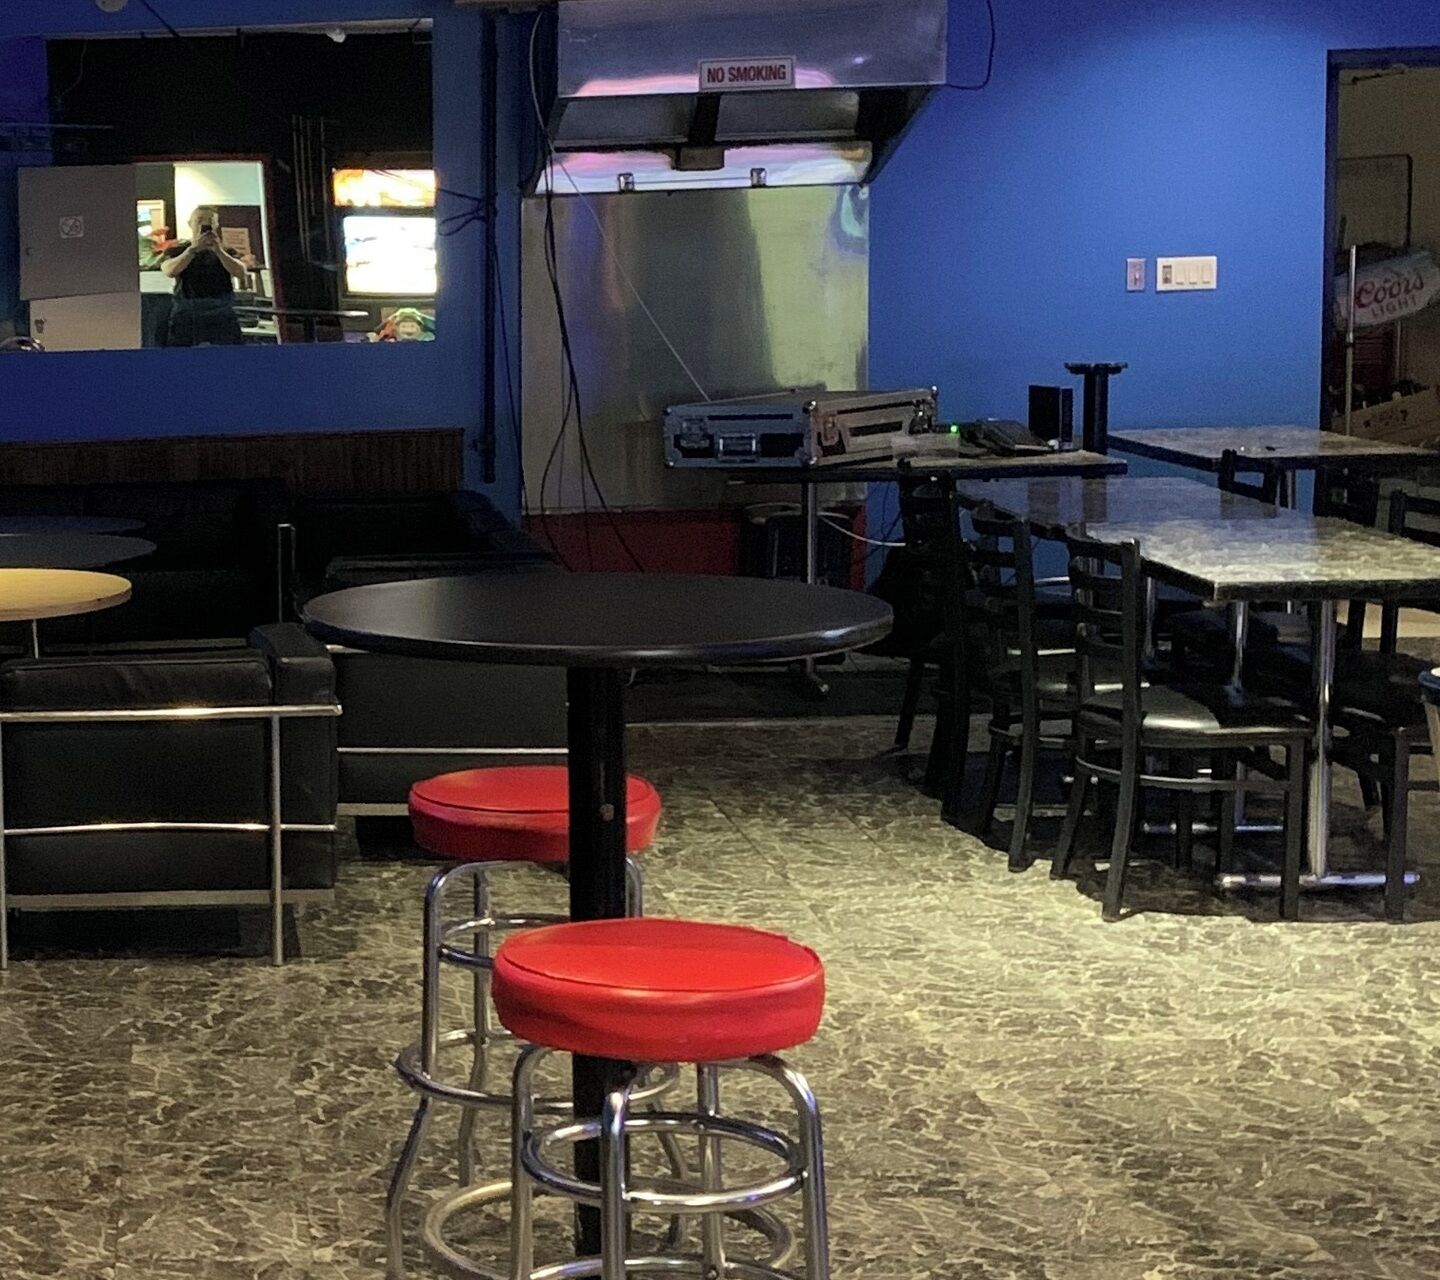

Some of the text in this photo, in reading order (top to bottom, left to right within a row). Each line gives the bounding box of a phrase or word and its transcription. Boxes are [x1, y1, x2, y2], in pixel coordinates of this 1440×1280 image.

[707, 65, 786, 82] NO SMOKING
[1355, 271, 1424, 308] Coors
[1372, 294, 1417, 317] LIGHT
